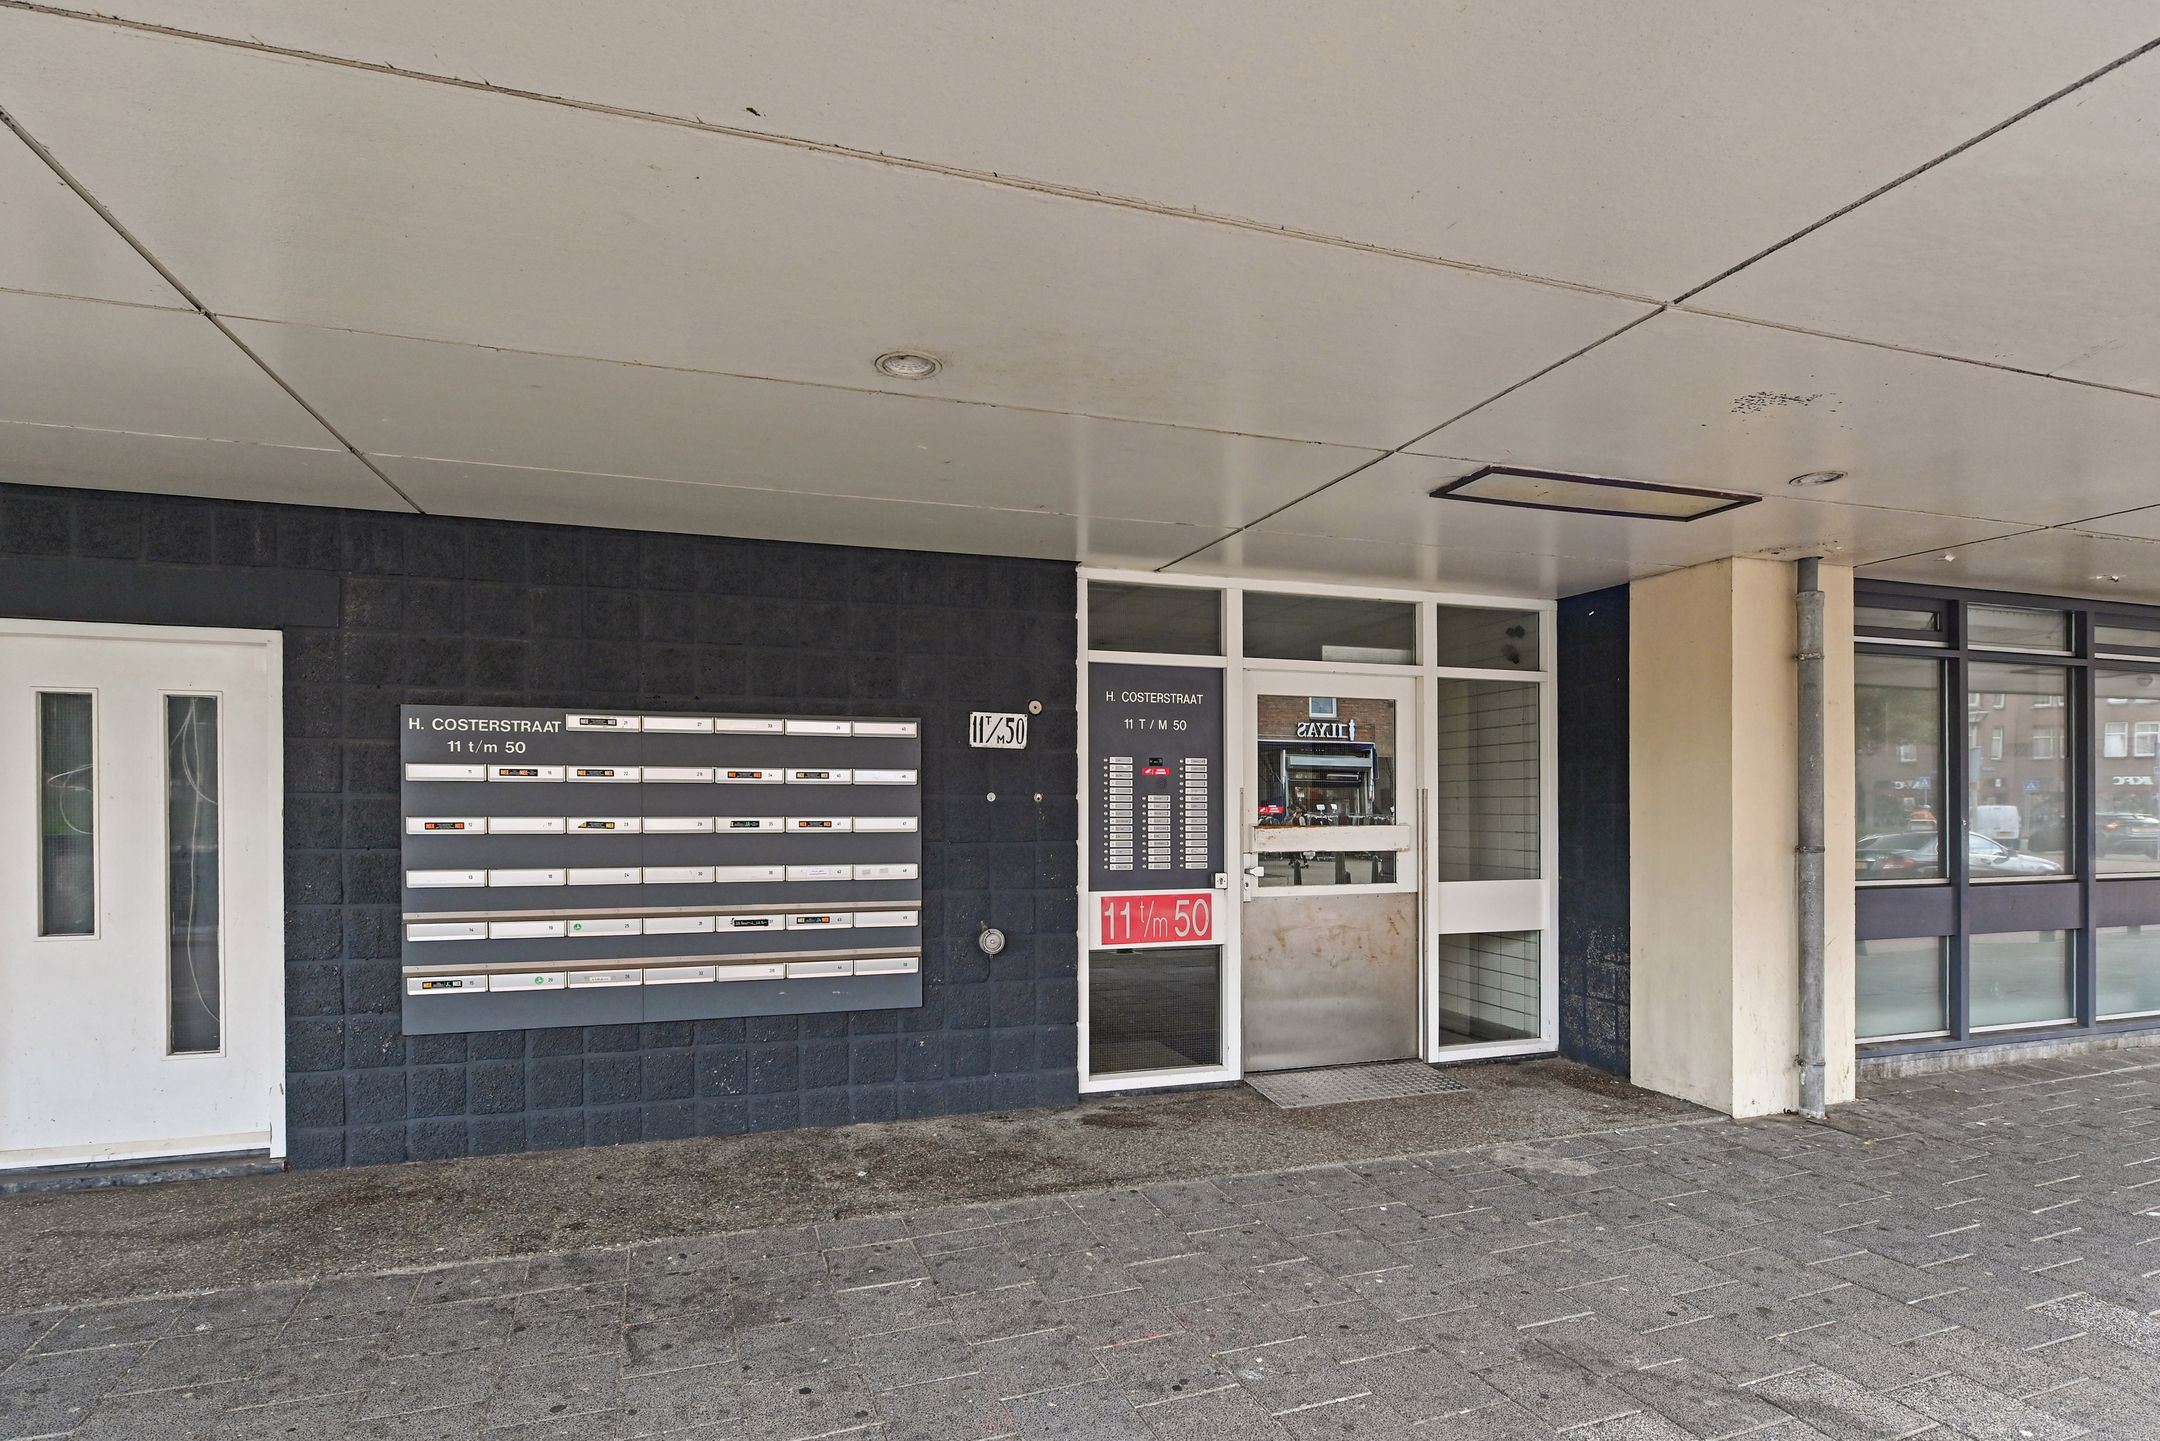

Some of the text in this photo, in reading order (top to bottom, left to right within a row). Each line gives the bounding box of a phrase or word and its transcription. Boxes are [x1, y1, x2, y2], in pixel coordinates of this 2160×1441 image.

[1106, 691, 1203, 704] H. COSTERSTRAAT
[408, 717, 561, 733] H. COSTERSTRAAT
[1006, 718, 1025, 744] 50
[1124, 718, 1133, 729] 11
[1173, 720, 1187, 730] 50
[447, 740, 526, 754] 11 t/m 50
[1104, 898, 1209, 939] 11 t/m 50
